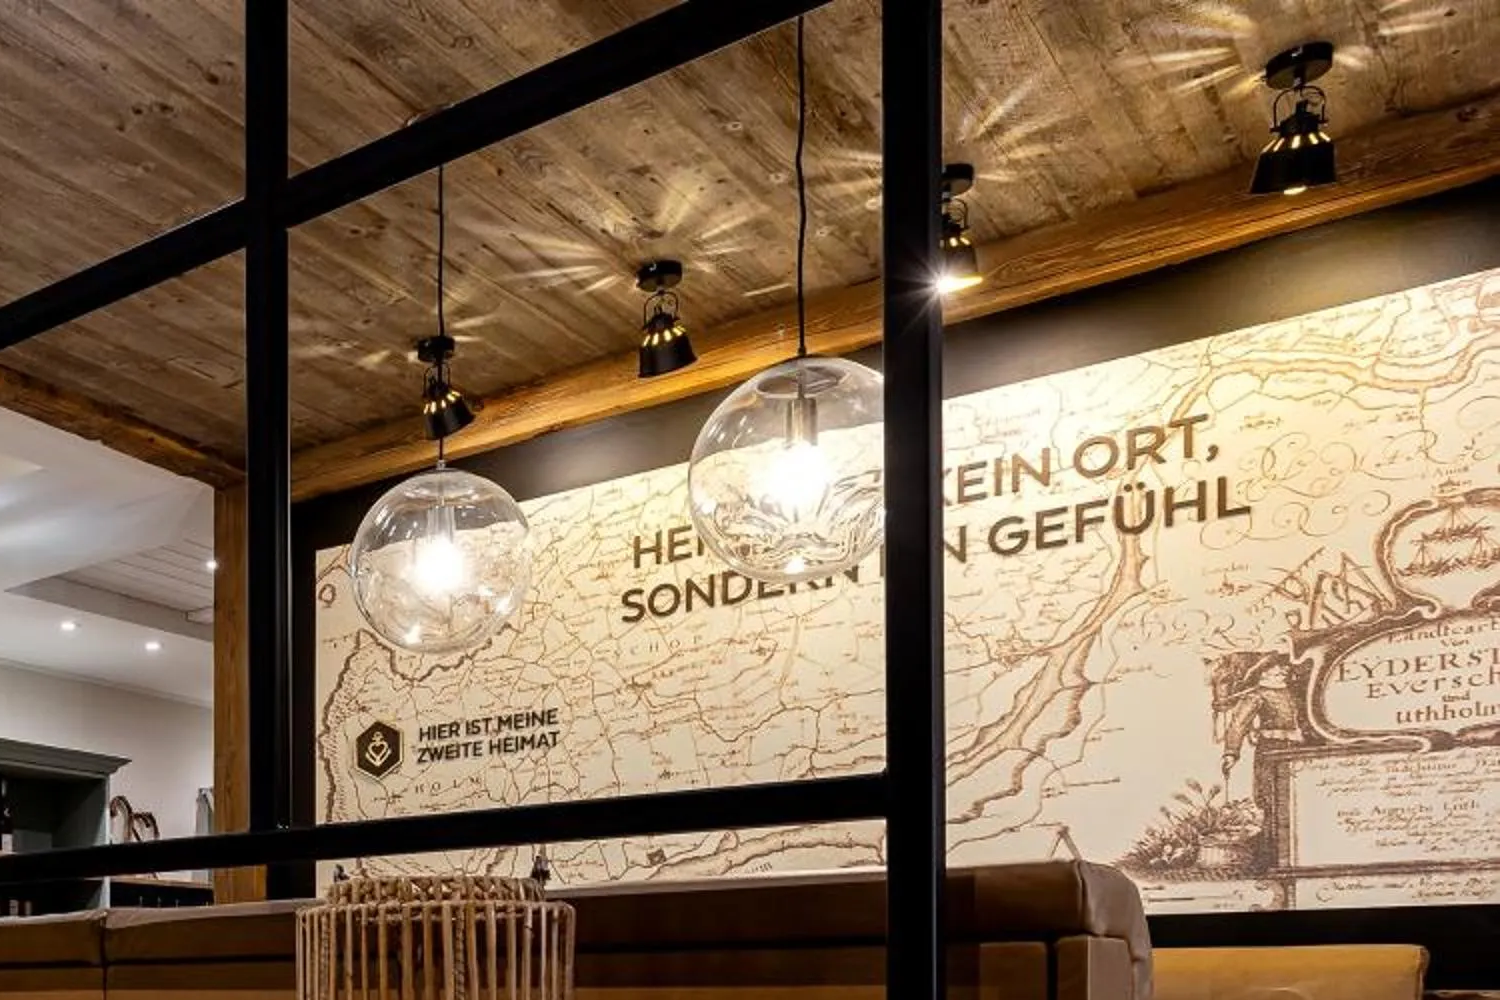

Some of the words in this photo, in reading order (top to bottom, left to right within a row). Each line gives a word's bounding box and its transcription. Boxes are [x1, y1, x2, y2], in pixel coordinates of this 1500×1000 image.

[943, 447, 1051, 506] EIN
[1073, 414, 1220, 479] ORT,
[987, 476, 1251, 556] GEFÜHL
[417, 740, 483, 764] ZWEITE
[489, 731, 560, 755] HEIMAT
[419, 721, 461, 742] HIER
[465, 717, 494, 736] IST
[498, 708, 559, 732] MEINE
